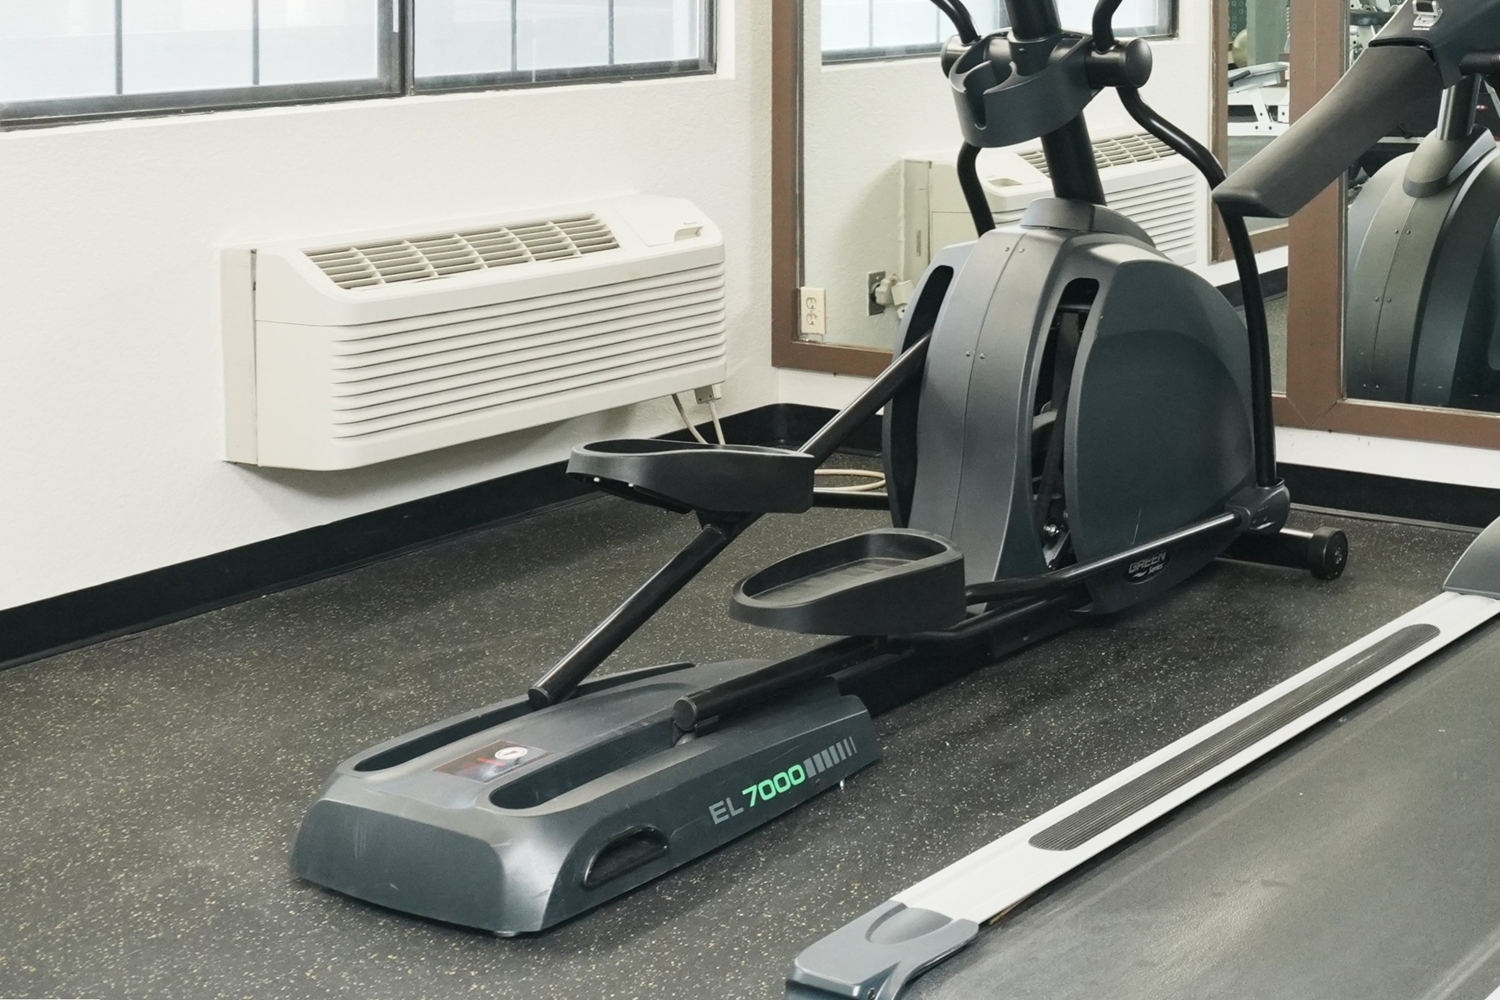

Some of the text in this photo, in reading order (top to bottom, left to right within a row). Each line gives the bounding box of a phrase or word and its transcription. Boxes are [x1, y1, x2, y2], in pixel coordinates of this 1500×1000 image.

[1129, 552, 1167, 574] GREEN
[708, 764, 806, 825] EL 7000
